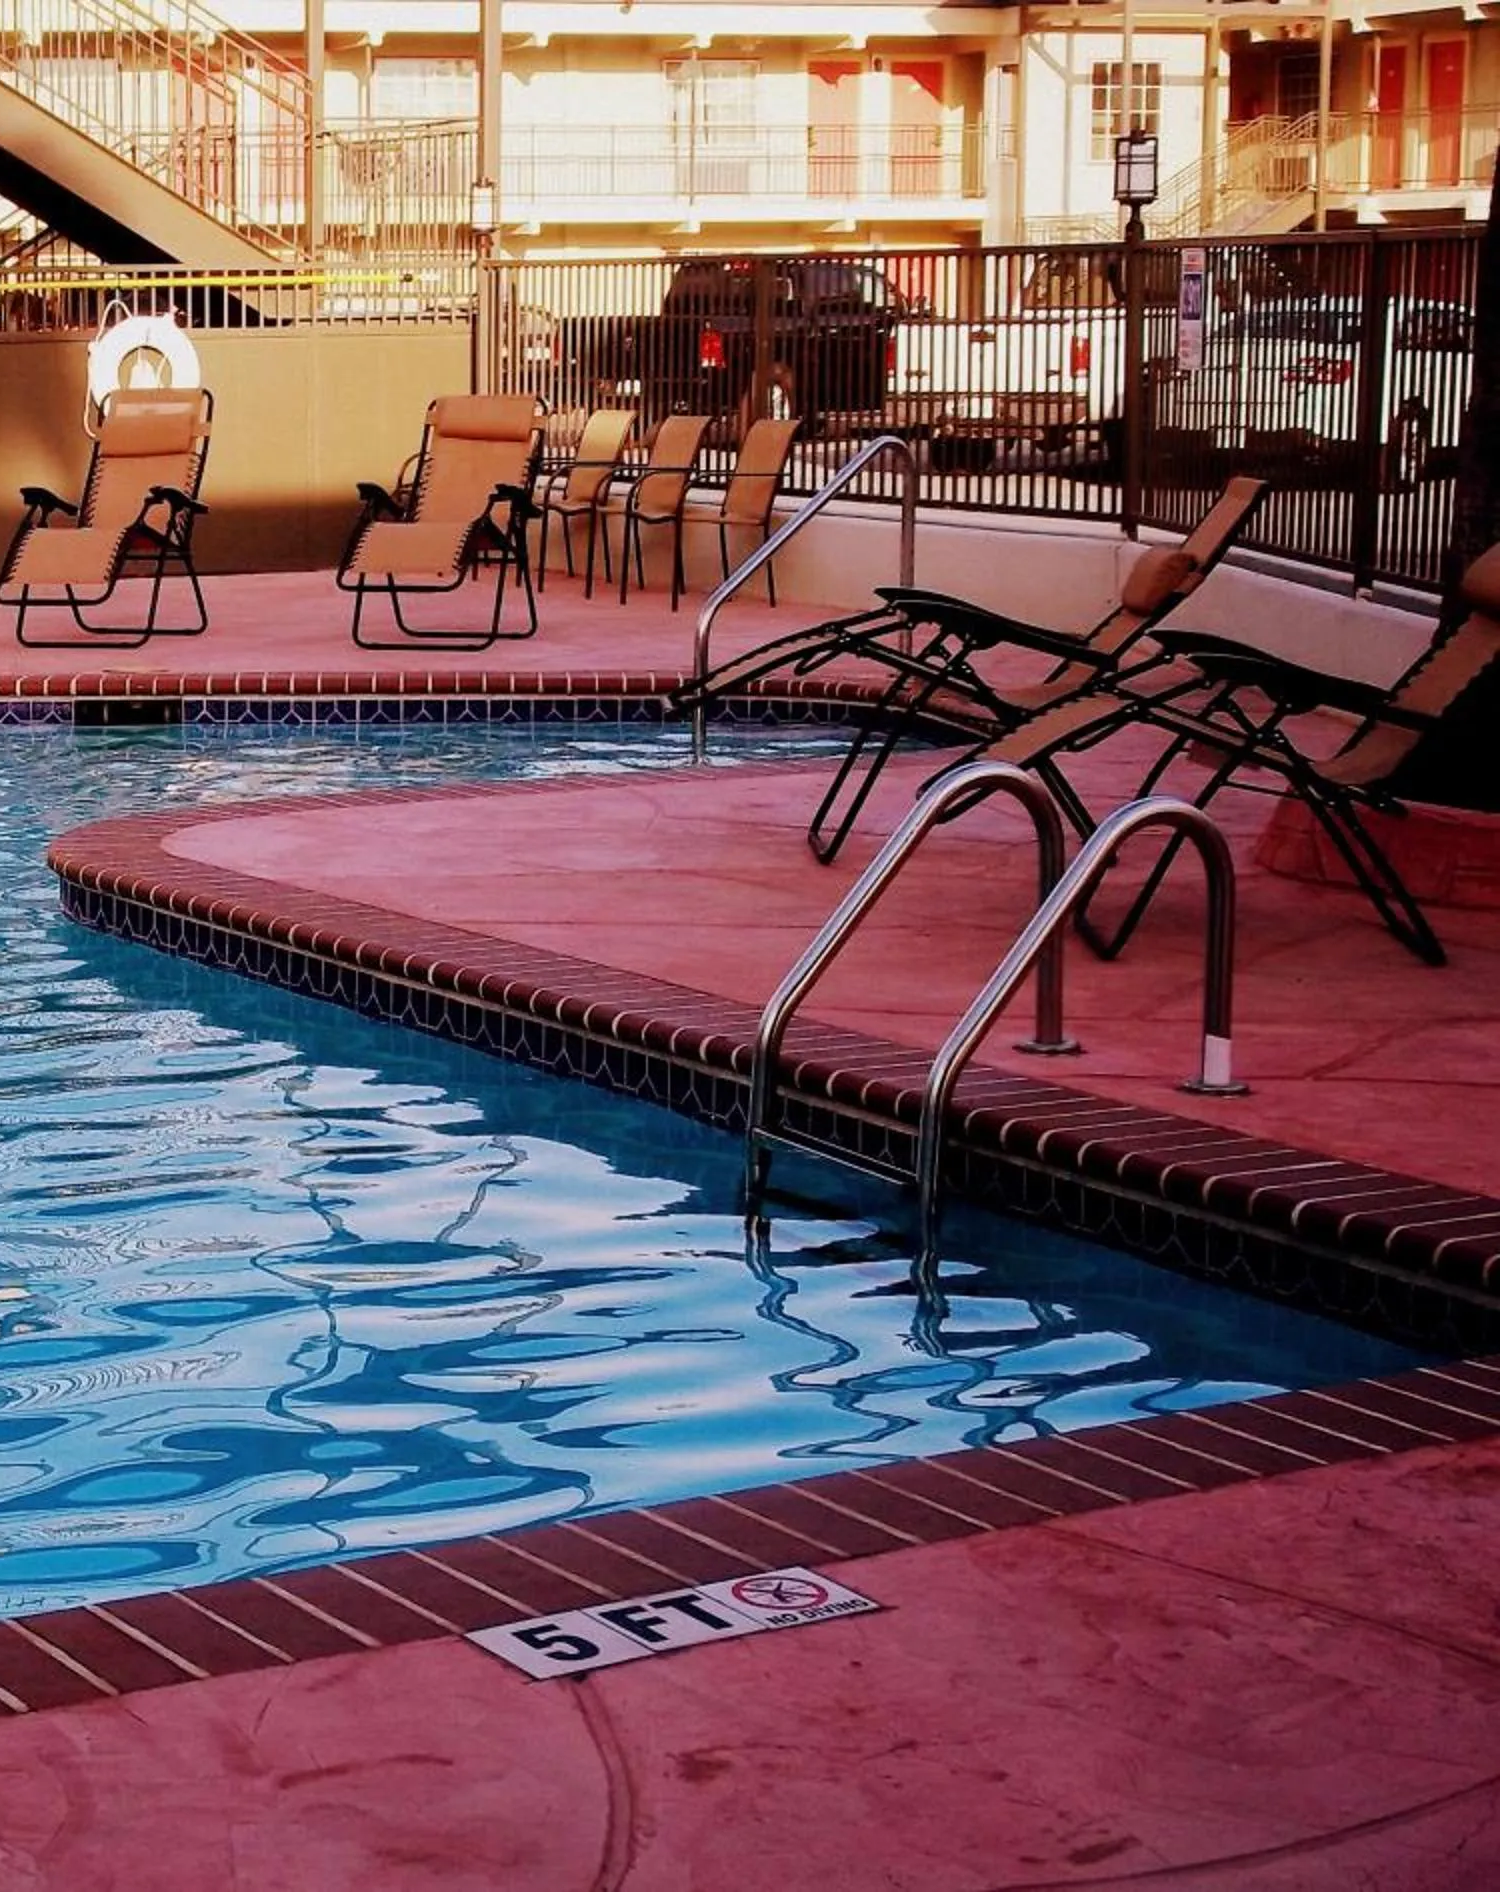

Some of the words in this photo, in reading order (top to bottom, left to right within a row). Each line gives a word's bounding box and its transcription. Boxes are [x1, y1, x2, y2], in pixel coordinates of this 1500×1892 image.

[512, 1623, 599, 1661] 5
[601, 1594, 734, 1643] FT
[765, 1613, 799, 1627] NO
[802, 1599, 870, 1620] DIVING
